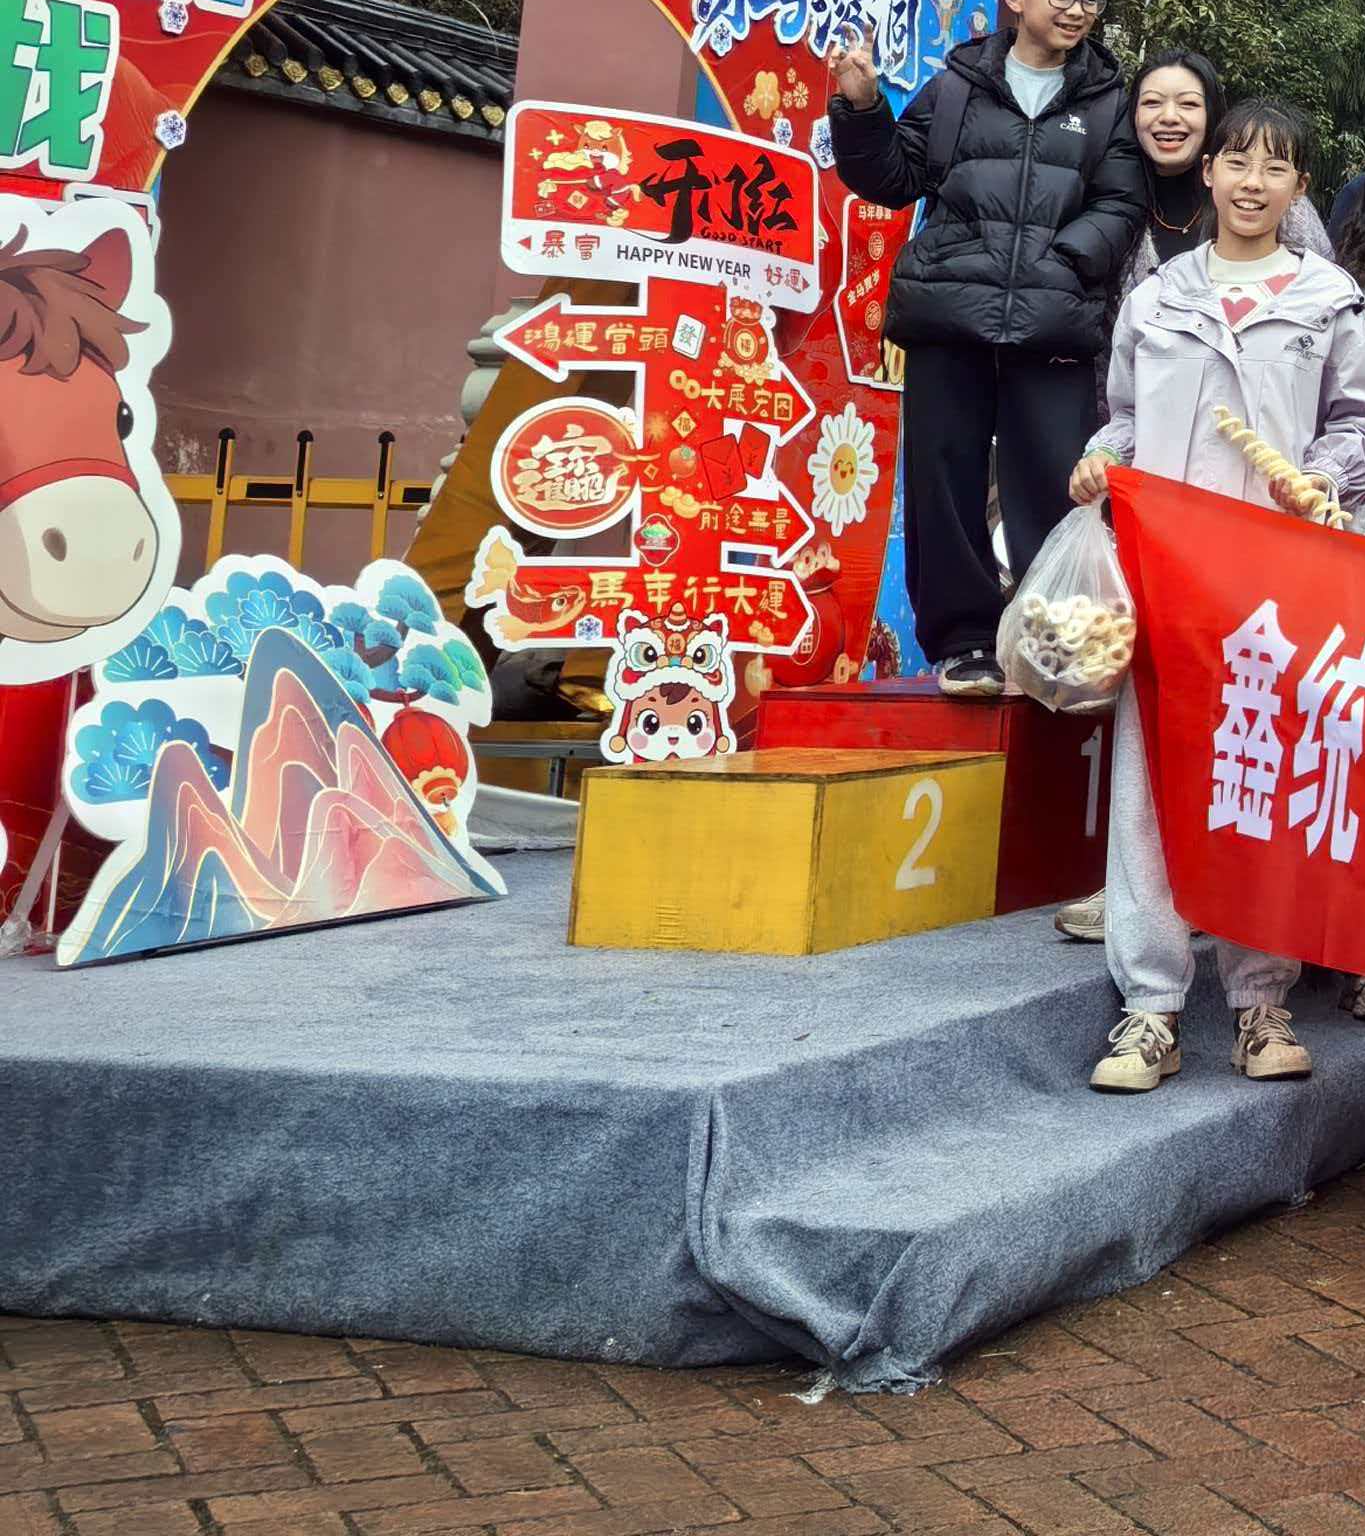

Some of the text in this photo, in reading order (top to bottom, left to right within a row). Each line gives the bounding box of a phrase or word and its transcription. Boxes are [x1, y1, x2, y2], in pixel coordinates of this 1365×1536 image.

[541, 230, 601, 261] 暴富
[616, 244, 751, 279] HAPPY NEW YEAR
[1079, 725, 1103, 838] 1
[895, 778, 944, 891] 2
